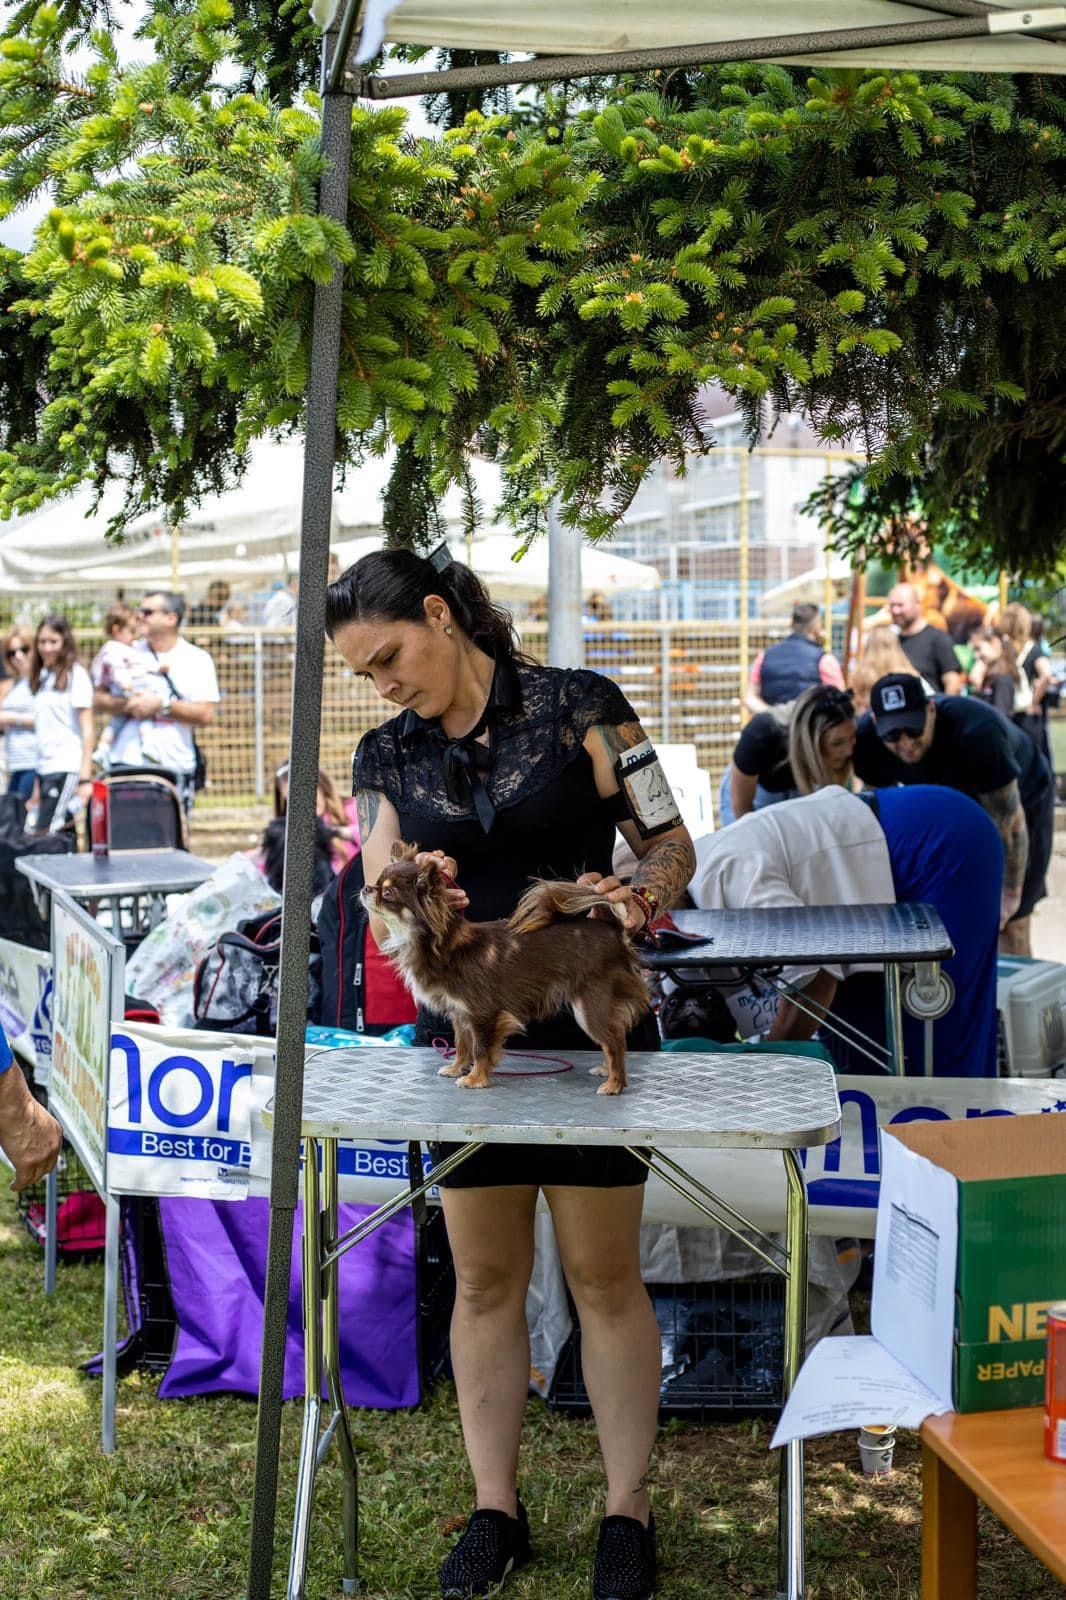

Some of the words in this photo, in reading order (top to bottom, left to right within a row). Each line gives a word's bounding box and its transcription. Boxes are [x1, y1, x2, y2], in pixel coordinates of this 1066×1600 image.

[141, 1132, 195, 1158] Best
[201, 1138, 232, 1162] for
[355, 1150, 409, 1176] Best
[977, 1358, 1045, 1381] PAPER
